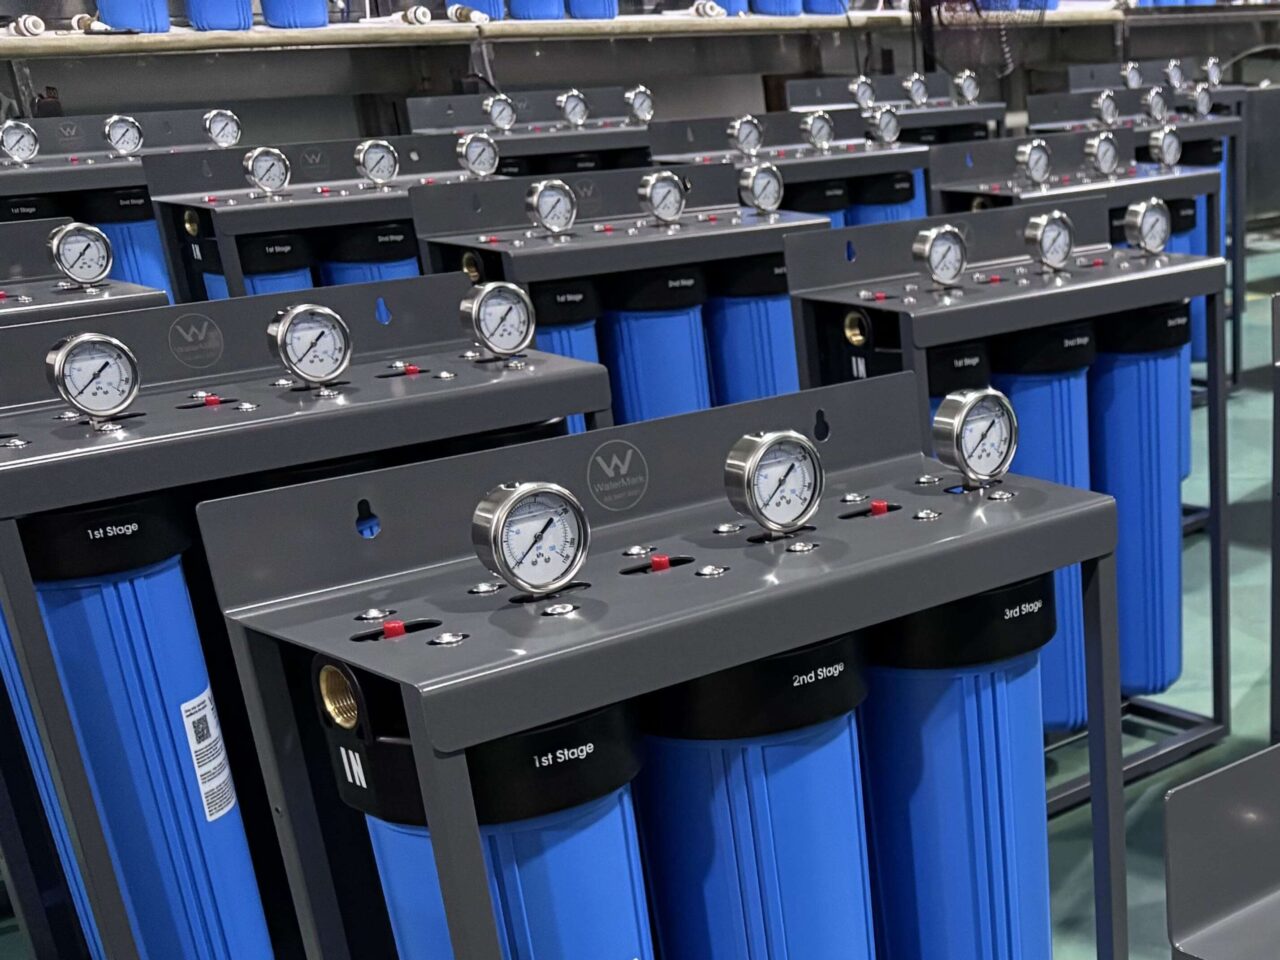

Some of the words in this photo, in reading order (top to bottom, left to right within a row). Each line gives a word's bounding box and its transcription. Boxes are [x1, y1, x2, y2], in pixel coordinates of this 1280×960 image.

[595, 449, 633, 478] W
[87, 527, 105, 540] 1st
[106, 522, 139, 537] Stage
[1003, 605, 1021, 620] 3rd
[1021, 599, 1043, 616] Stage
[792, 670, 816, 687] 2nd
[817, 662, 845, 680] Stage
[339, 745, 368, 789] IN
[533, 752, 553, 768] 1st
[556, 742, 595, 763] Stage
